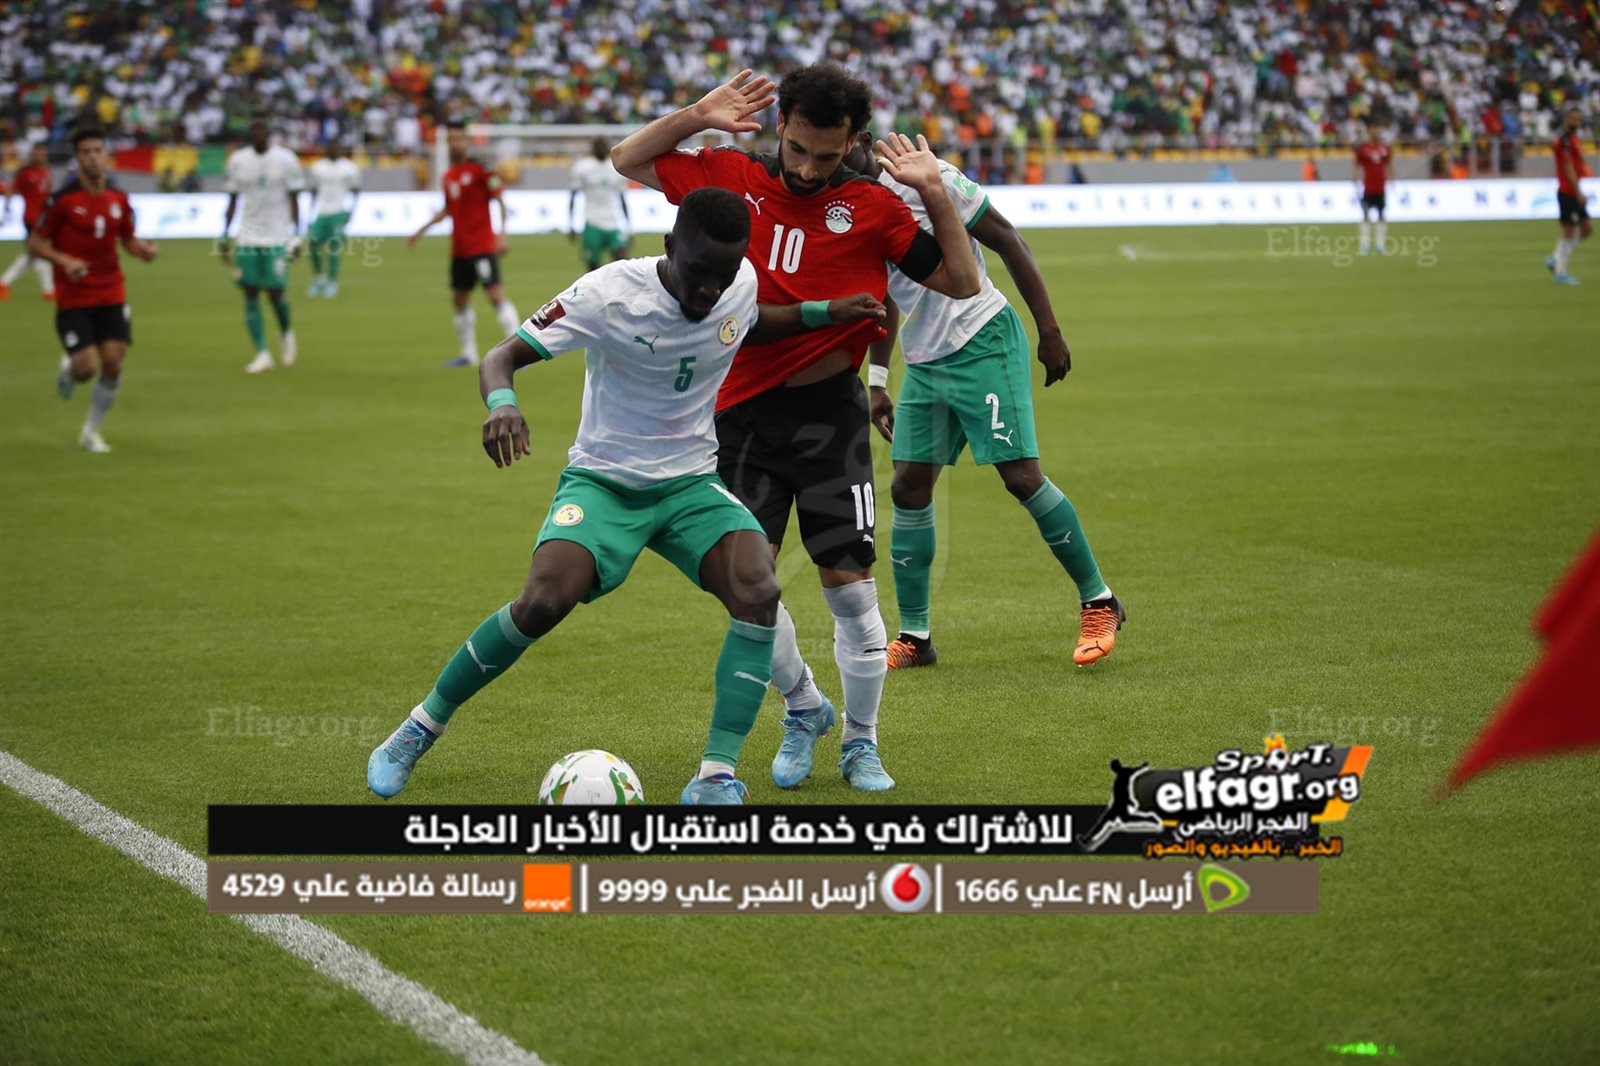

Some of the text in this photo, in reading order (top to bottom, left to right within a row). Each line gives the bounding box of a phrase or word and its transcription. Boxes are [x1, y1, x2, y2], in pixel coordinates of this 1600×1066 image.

[768, 223, 805, 274] 10
[673, 356, 697, 393] 5
[985, 393, 1006, 431] 2
[851, 482, 876, 531] 10
